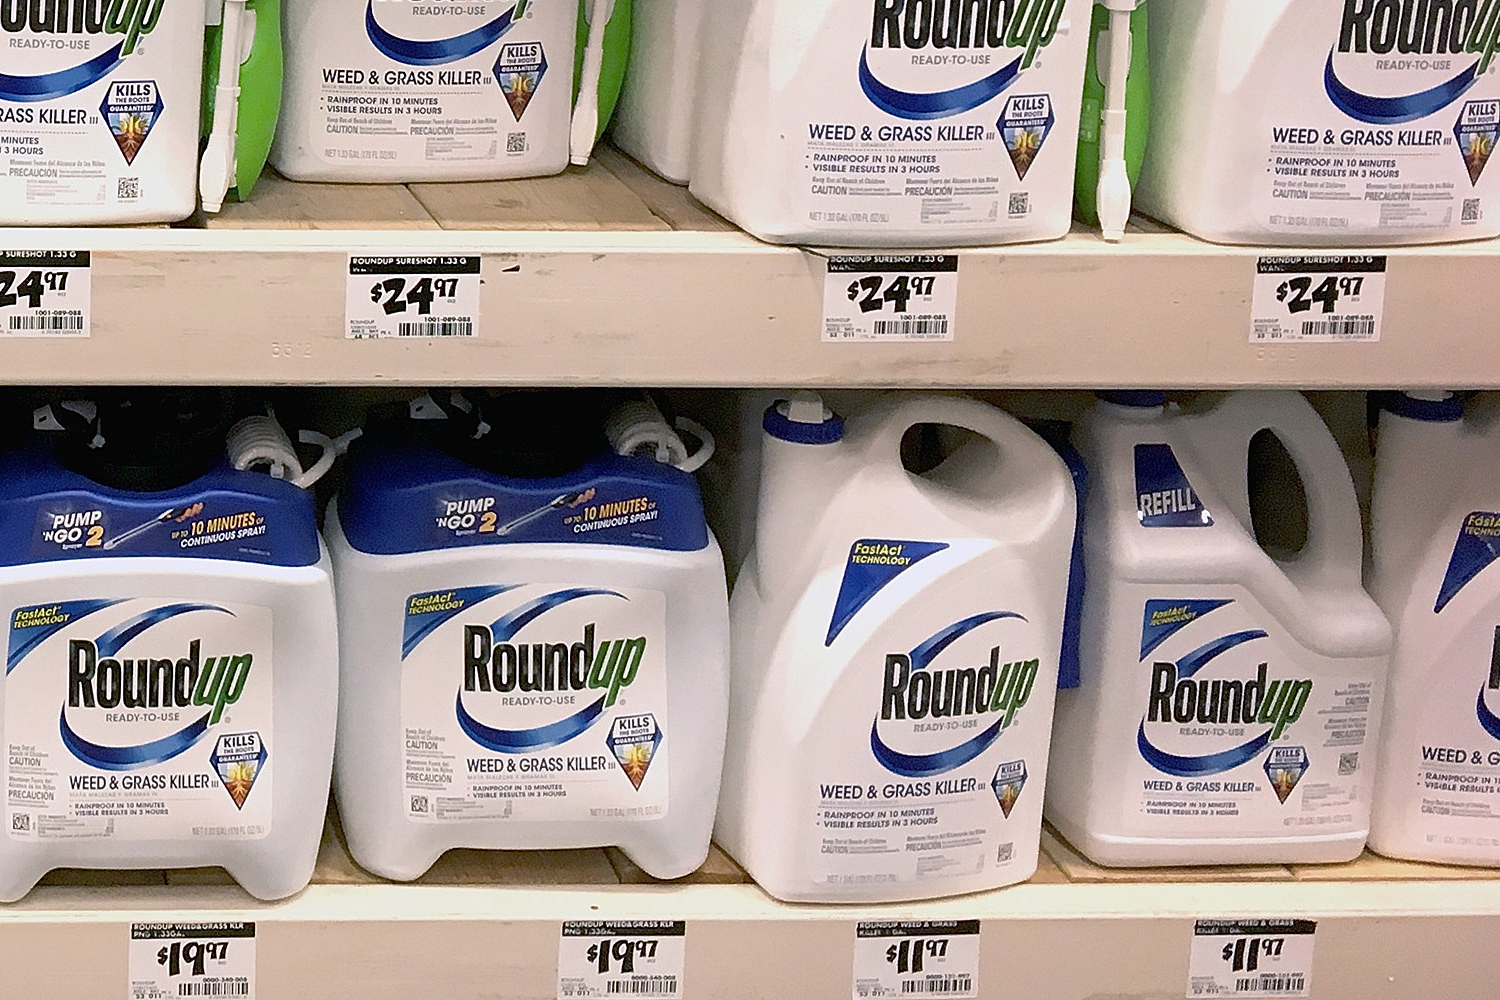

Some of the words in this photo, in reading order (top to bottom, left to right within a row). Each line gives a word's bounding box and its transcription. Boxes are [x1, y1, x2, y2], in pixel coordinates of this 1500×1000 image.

[413, 6, 485, 16] READY-TO-USE
[10, 39, 90, 49] READY-TO-USE
[1376, 60, 1451, 70] READY-TO-USE
[116, 84, 150, 96] KILLS
[38, 107, 86, 124] KILLER
[352, 257, 393, 265] ROUNDUP
[396, 257, 437, 265] SURESHOT
[1141, 490, 1196, 515] REFILL
[53, 512, 102, 528] PUMP
[191, 520, 202, 535] 10
[206, 513, 255, 529] MINUTES
[855, 544, 902, 555] FastAct
[852, 555, 910, 565] TECHNOLOGY
[16, 607, 57, 620] FastAct
[14, 614, 69, 628] TECHNOLOGY
[465, 624, 646, 712] Roundup
[68, 639, 252, 727] Roundup
[882, 646, 1038, 730] Roundup
[1148, 663, 1312, 742] Roundup
[106, 713, 180, 723] READY-TO-USE
[224, 735, 254, 748] KILLS
